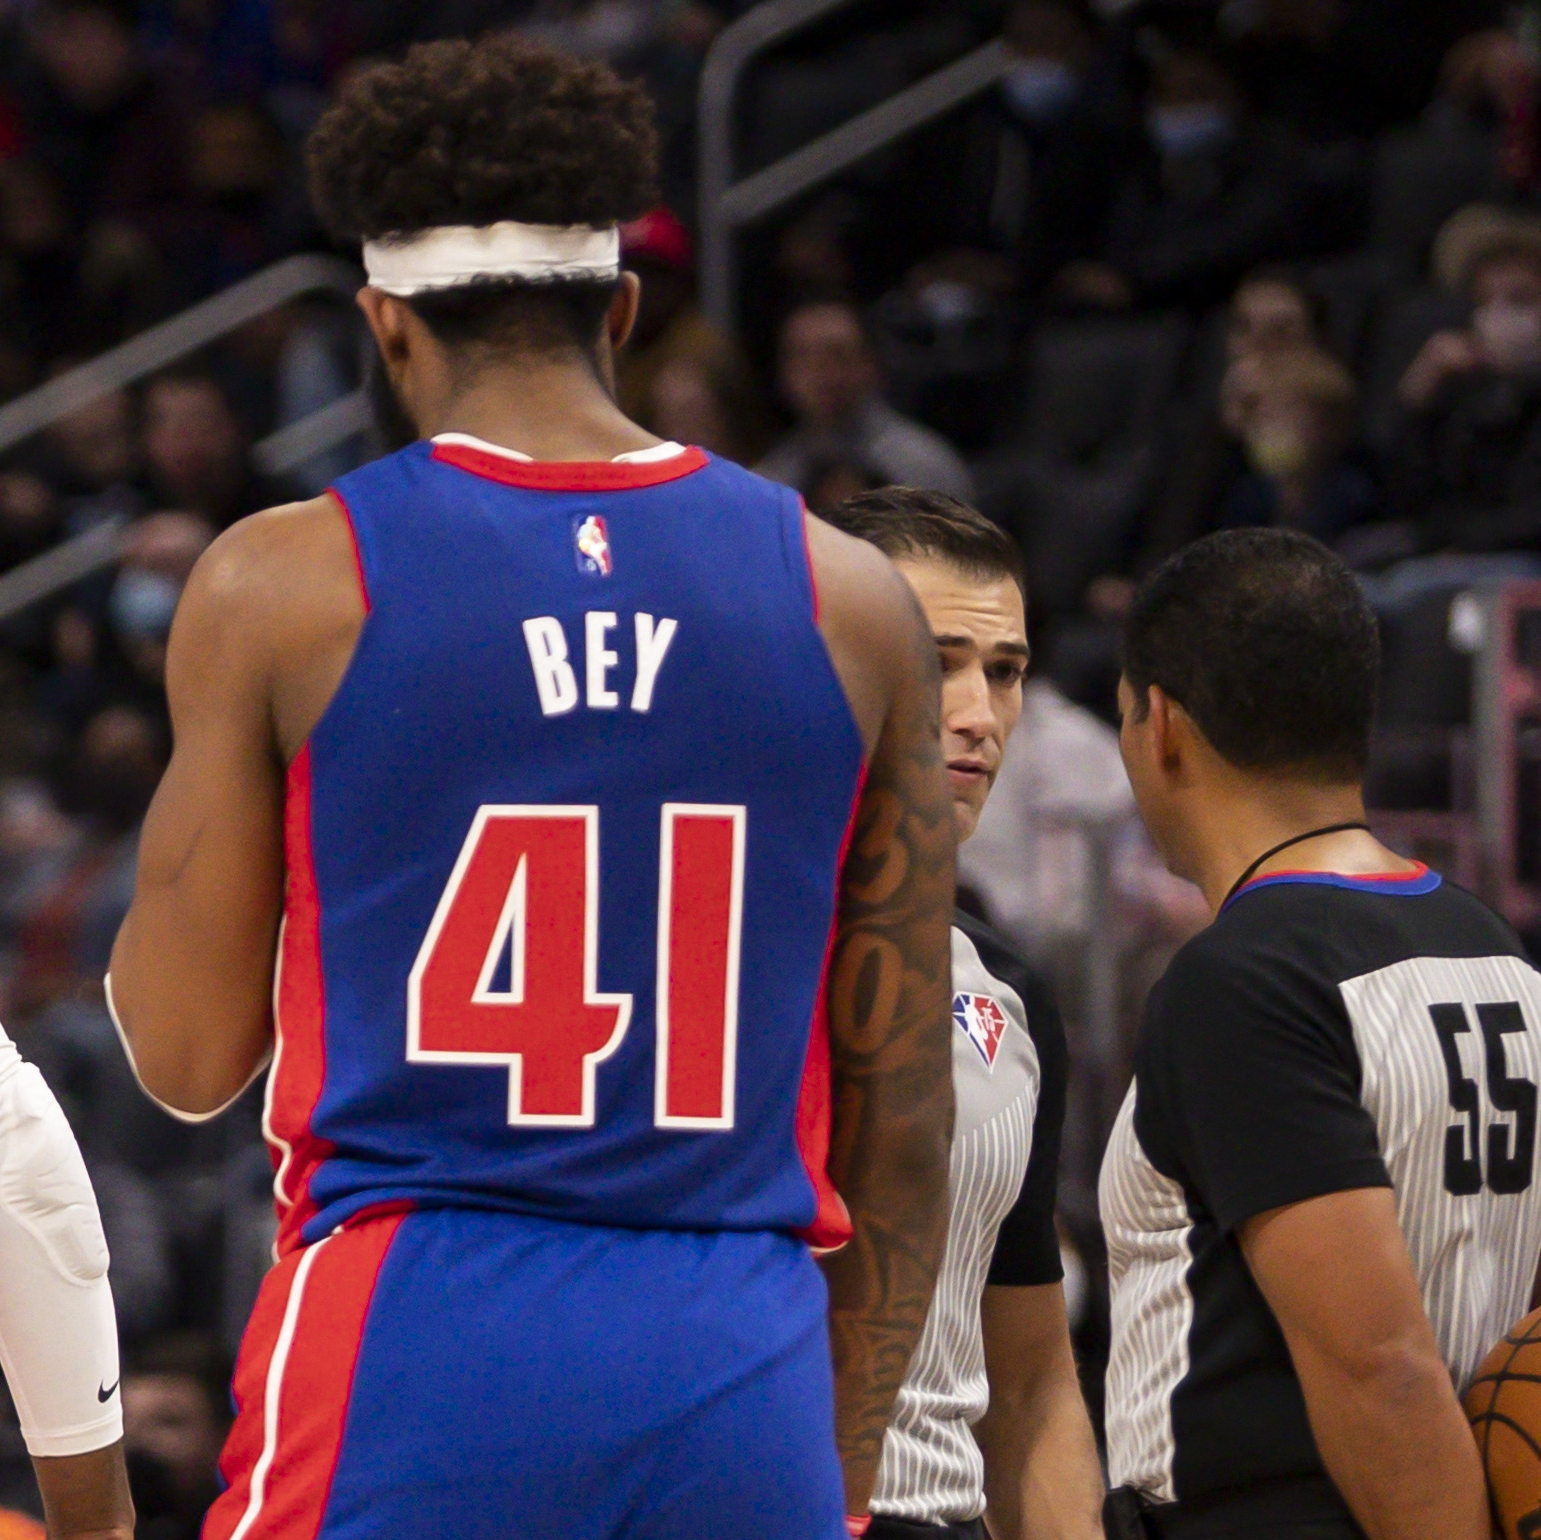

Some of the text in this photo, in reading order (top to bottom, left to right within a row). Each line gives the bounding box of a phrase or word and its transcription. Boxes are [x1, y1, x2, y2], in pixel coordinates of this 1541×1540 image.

[522, 611, 678, 716] BEY
[406, 802, 746, 1130] 41
[1428, 1001, 1537, 1196] 55
